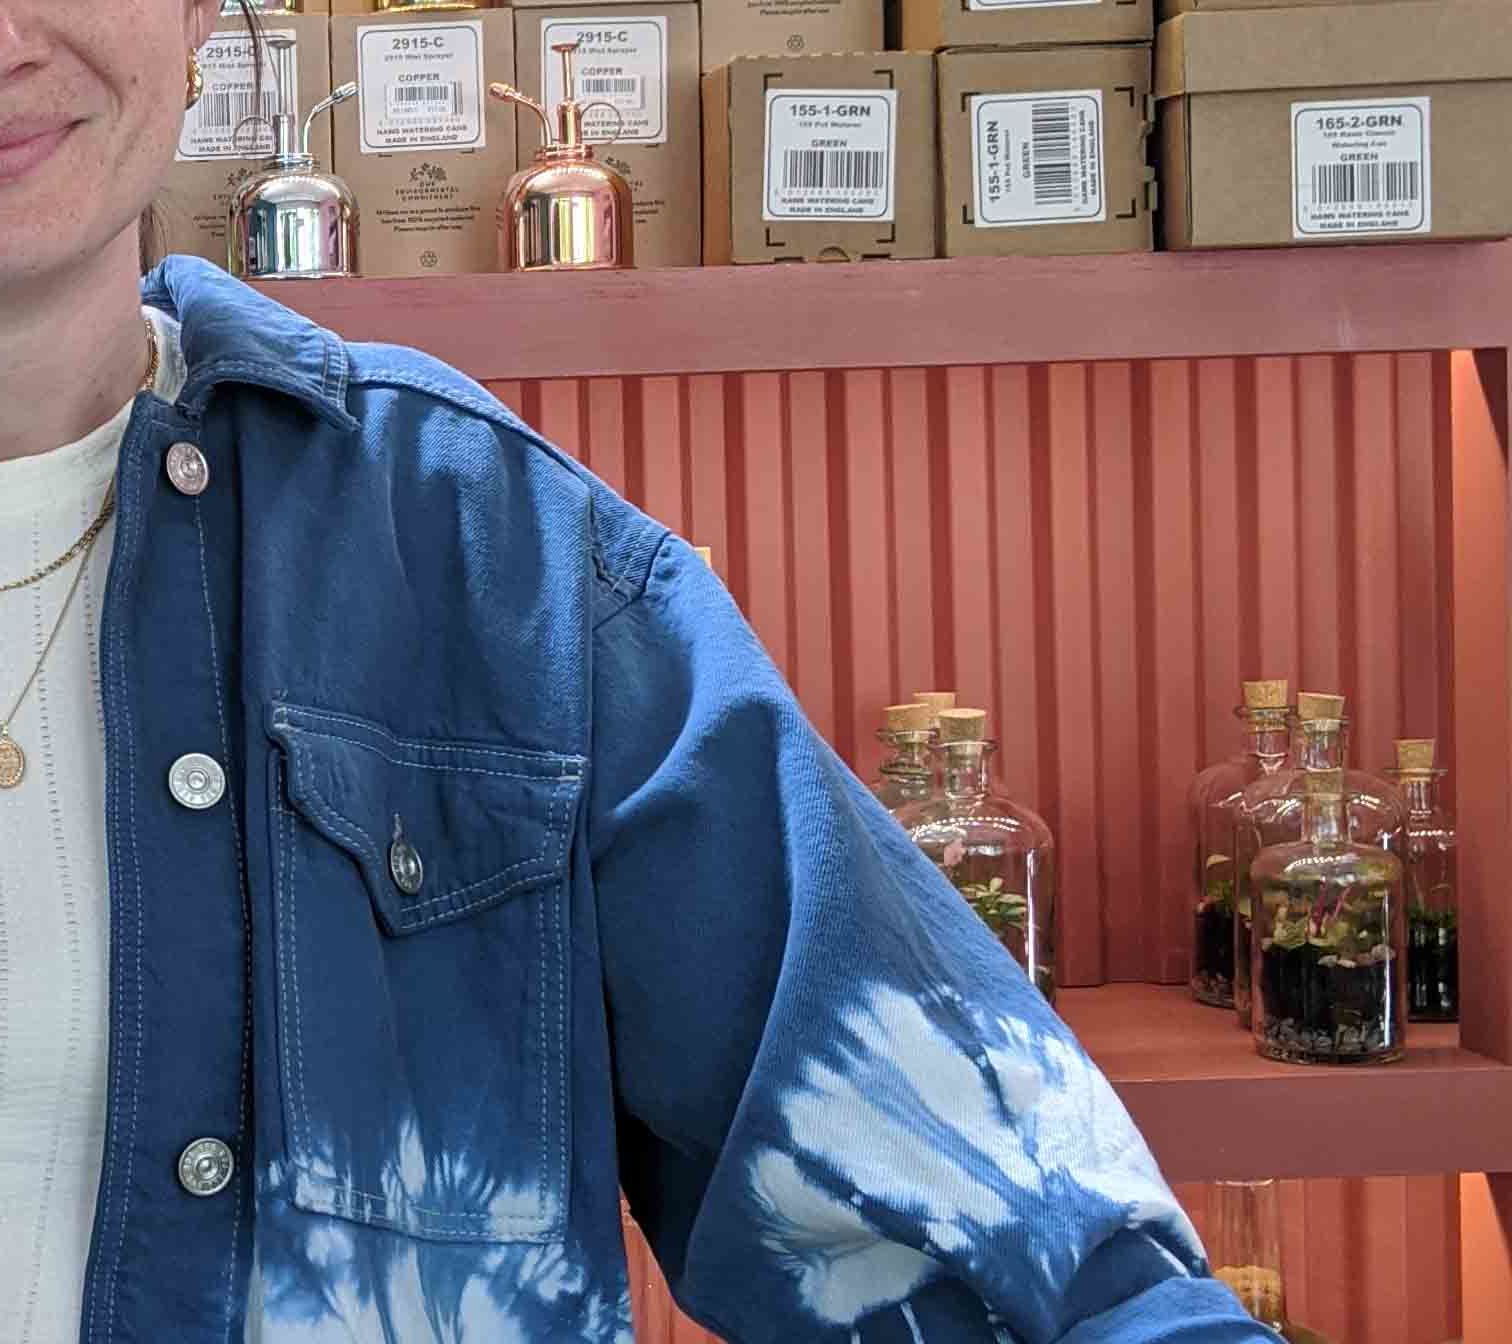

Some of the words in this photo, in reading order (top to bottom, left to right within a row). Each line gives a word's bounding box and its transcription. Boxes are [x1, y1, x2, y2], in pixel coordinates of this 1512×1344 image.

[392, 37, 444, 50] 2915-C
[576, 31, 628, 43] 2915-C
[398, 73, 440, 82] COPPER
[790, 104, 871, 117] 155-1-GRN
[1316, 114, 1403, 130] 165-2-GRN
[811, 139, 847, 147] GREEN
[986, 120, 1000, 203] 155-1-GRN
